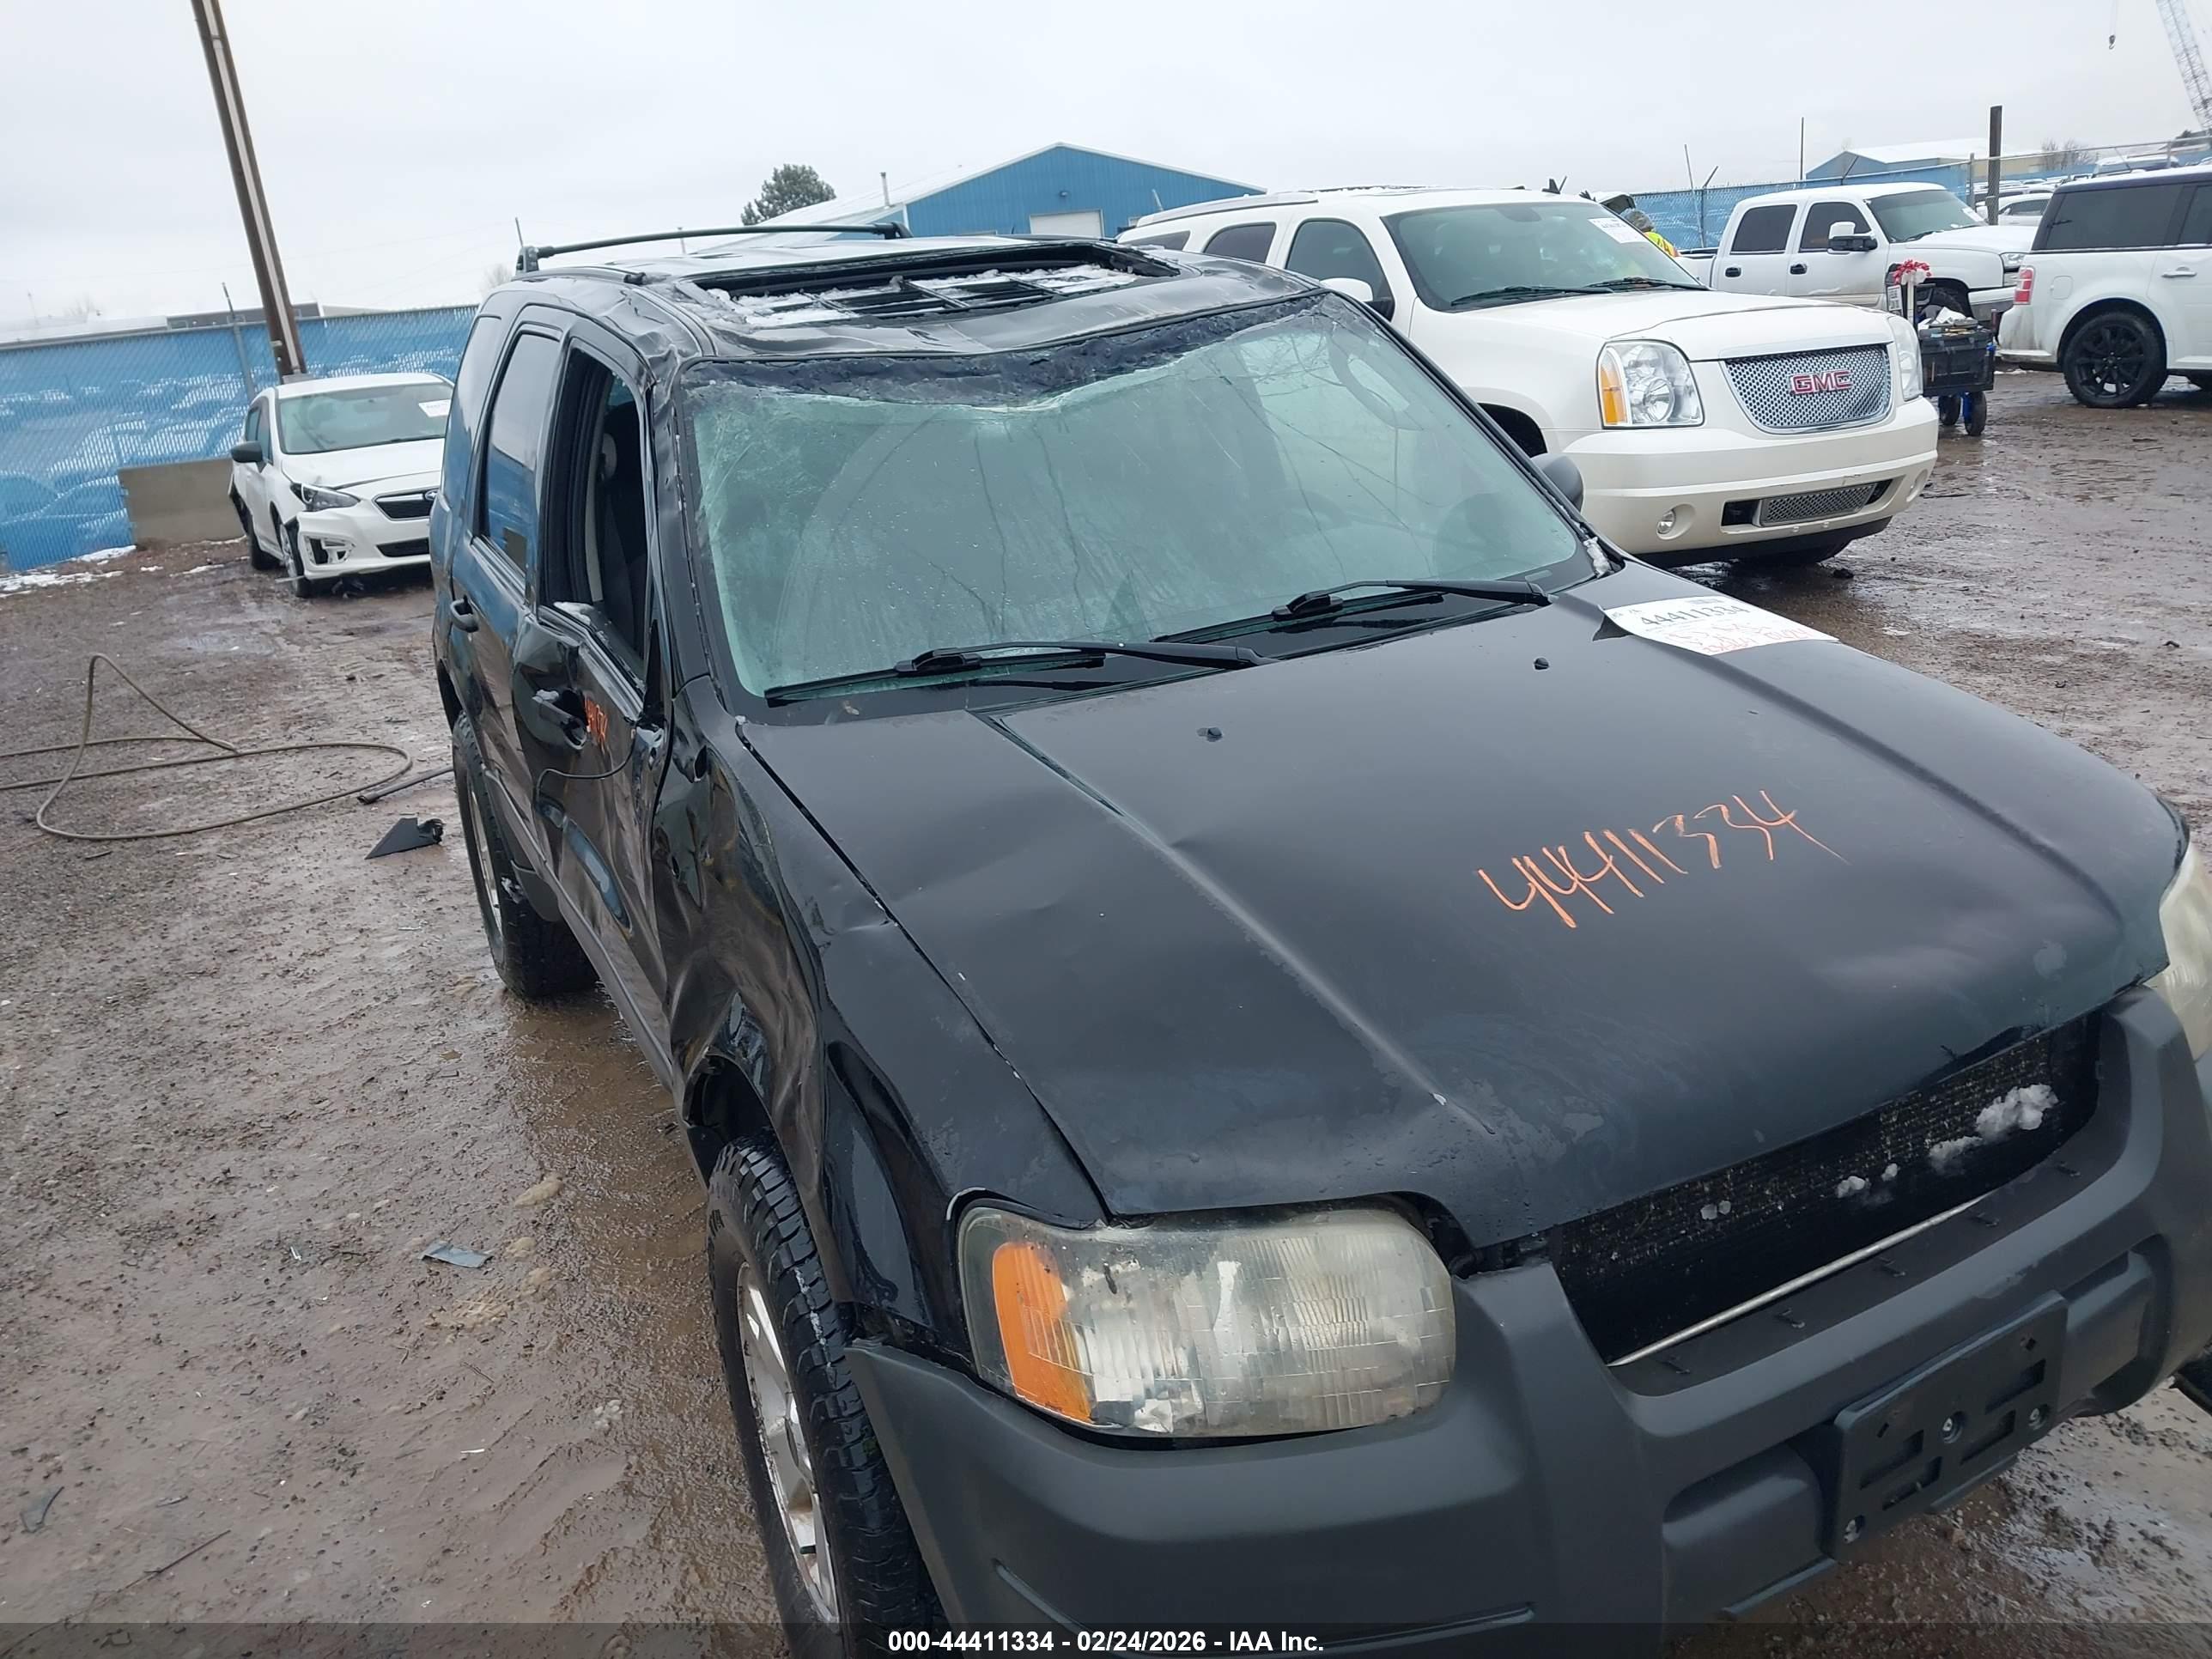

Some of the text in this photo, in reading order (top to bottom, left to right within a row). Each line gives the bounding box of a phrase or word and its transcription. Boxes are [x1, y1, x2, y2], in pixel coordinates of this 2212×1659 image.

[1790, 370, 1854, 394] GMC
[1639, 605, 1751, 626] 44411334
[1477, 790, 1851, 928] 44411334
